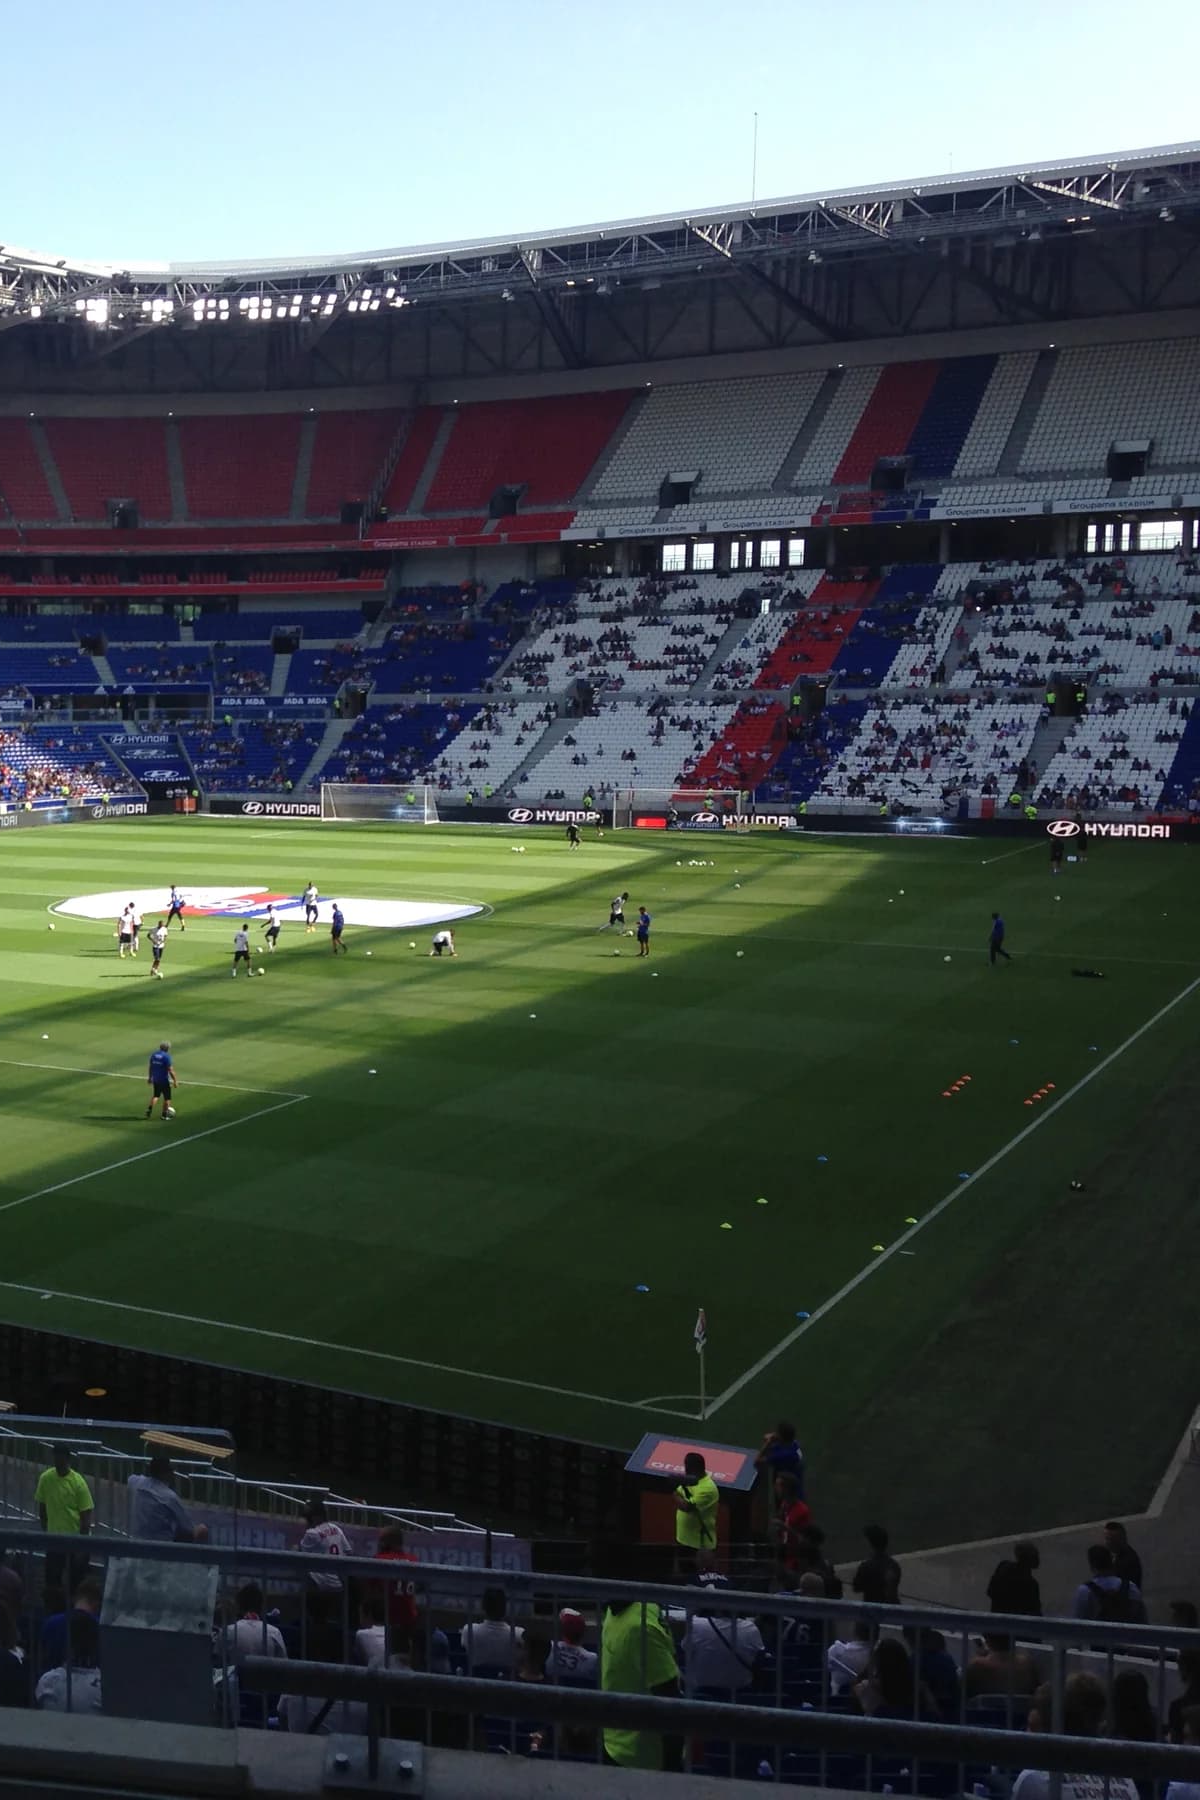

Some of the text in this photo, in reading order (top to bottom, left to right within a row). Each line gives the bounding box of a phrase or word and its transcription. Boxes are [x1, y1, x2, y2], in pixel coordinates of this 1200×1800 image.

[1118, 500, 1155, 508] STADIUM
[284, 697, 328, 705] MDA MDA
[127, 735, 169, 744] HYUNDAI
[105, 803, 147, 816] HYUNDAI
[265, 803, 320, 815] HYUNDAI
[536, 810, 597, 822] HYUNDA
[1084, 822, 1171, 838] HYUNDAI
[650, 1461, 727, 1480] orae
[783, 1616, 812, 1641] 76
